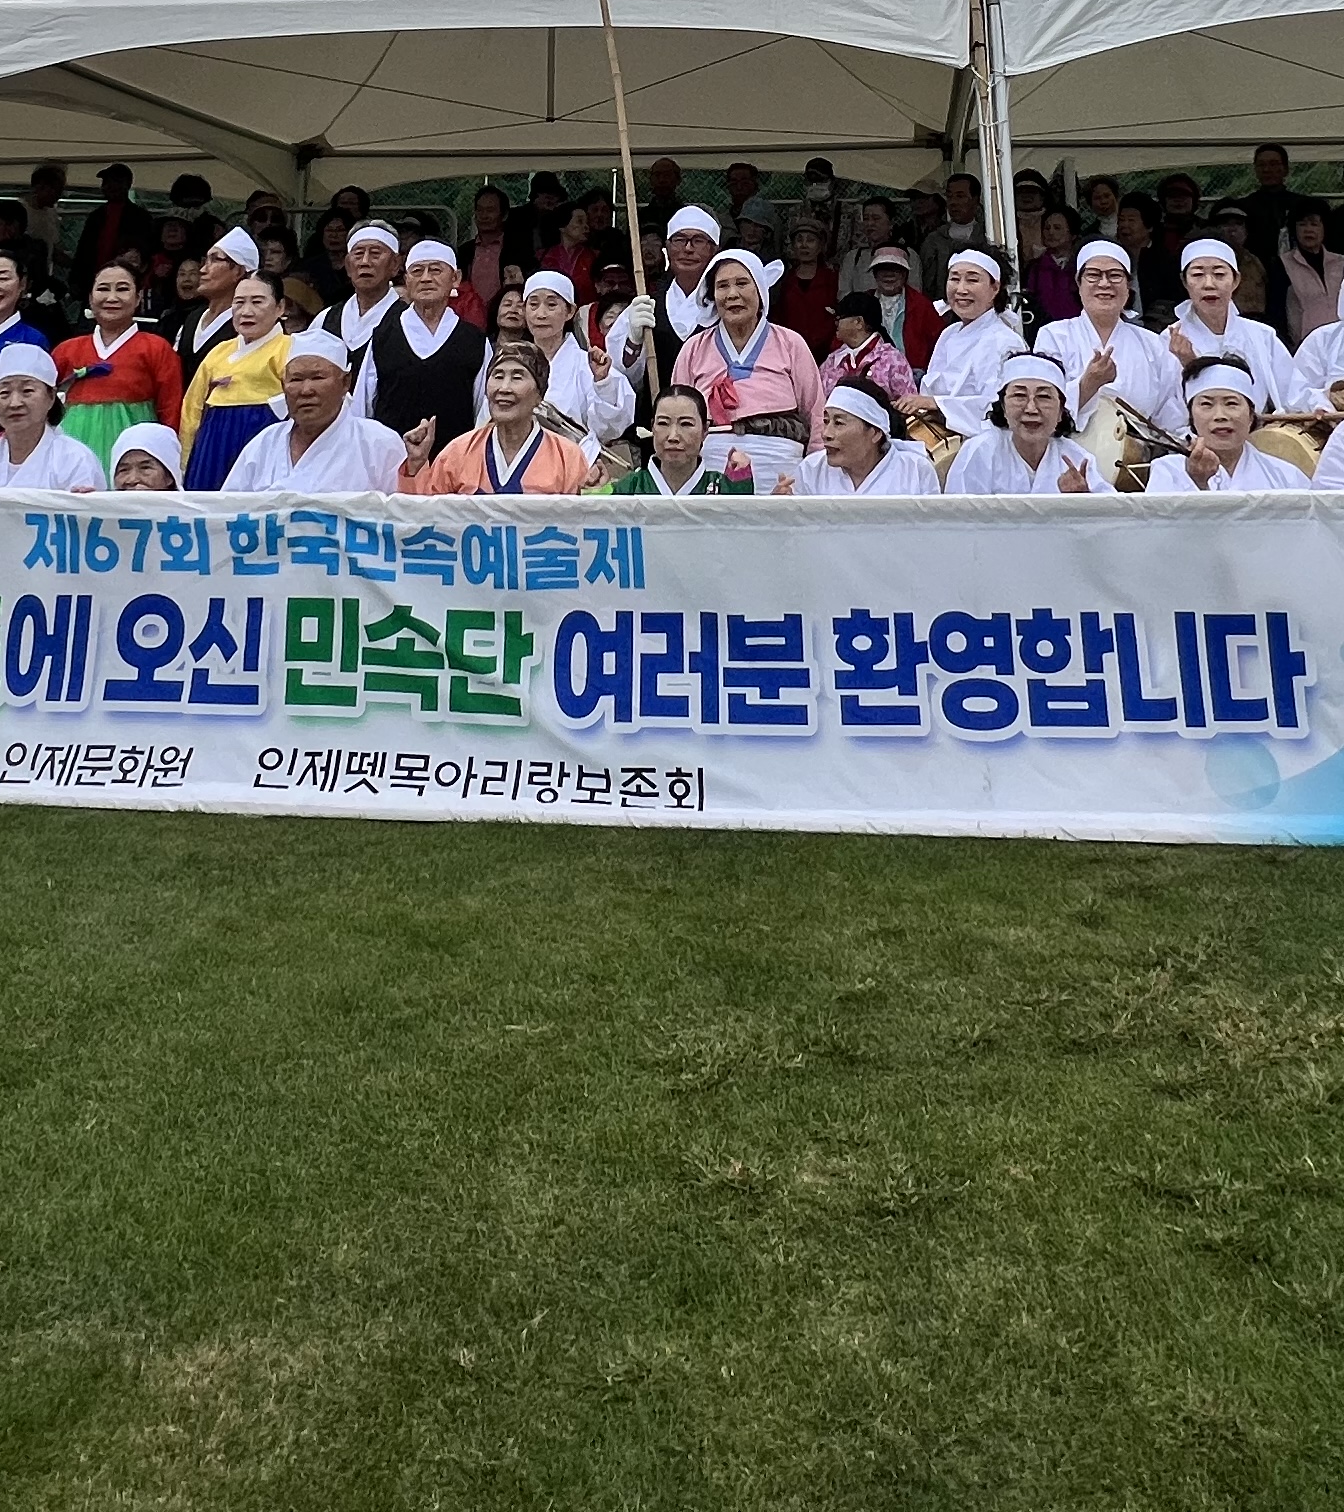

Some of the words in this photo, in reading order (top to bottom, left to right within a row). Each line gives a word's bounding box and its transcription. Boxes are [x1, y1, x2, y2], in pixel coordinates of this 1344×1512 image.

[24, 513, 211, 576] 제67회
[227, 511, 646, 591] 한국민속예술제
[103, 594, 264, 706] 오신
[284, 597, 534, 717] 민속단
[554, 609, 812, 726] 여러분
[832, 608, 1307, 731] 환영합니다
[253, 746, 706, 812] 인제뗏목아리랑보존회
